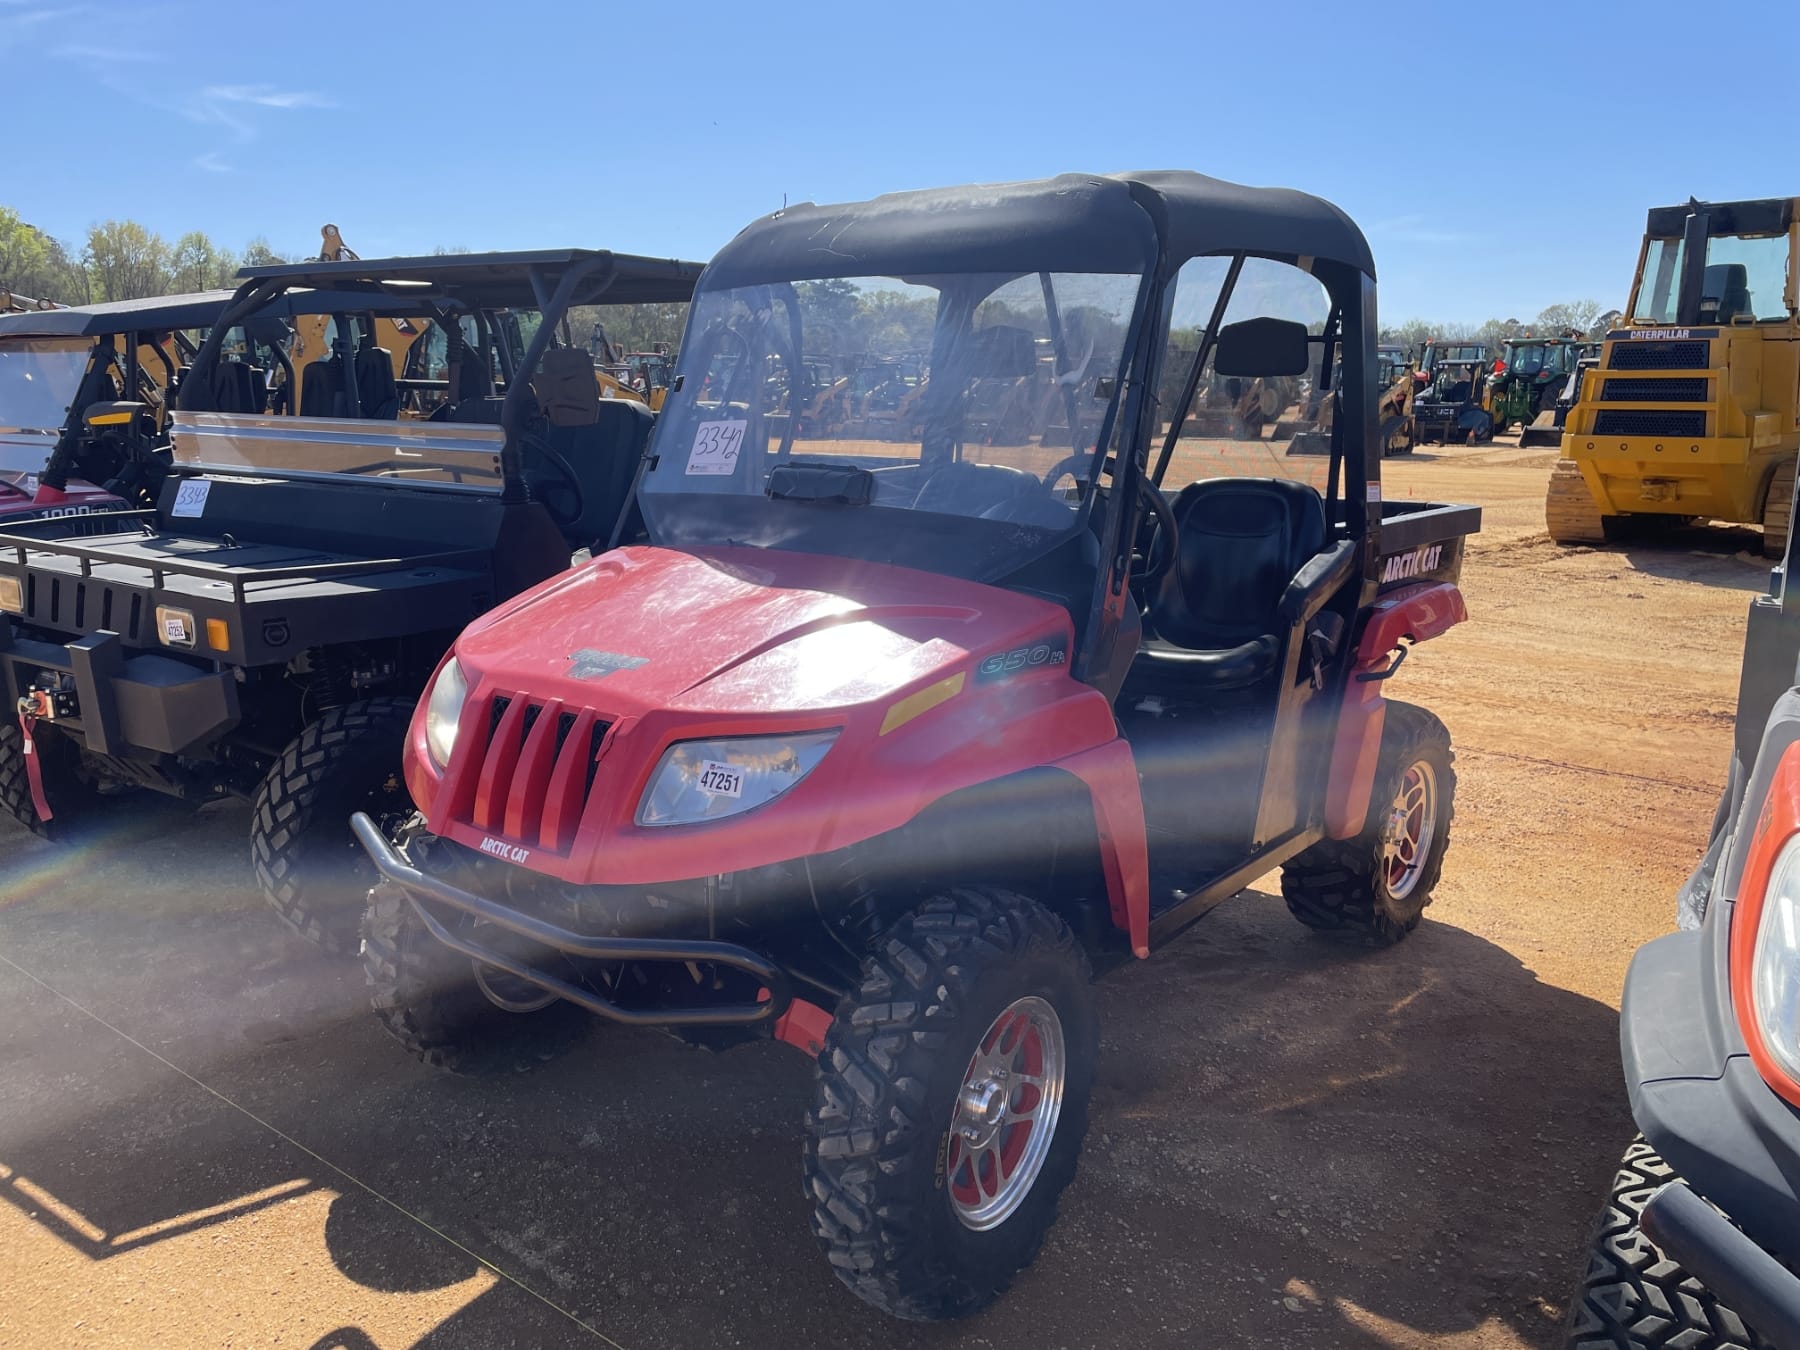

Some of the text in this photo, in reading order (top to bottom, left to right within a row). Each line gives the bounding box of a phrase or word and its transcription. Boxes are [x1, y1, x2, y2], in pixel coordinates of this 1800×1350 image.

[1630, 329, 1690, 339] CATERPILLAR
[695, 426, 742, 459] 3342
[176, 486, 208, 505] 3343
[1382, 545, 1443, 584] ARCTIC CAT
[981, 644, 1050, 674] 650
[700, 770, 740, 793] 47251
[480, 837, 530, 864] ARCTIC CAT
